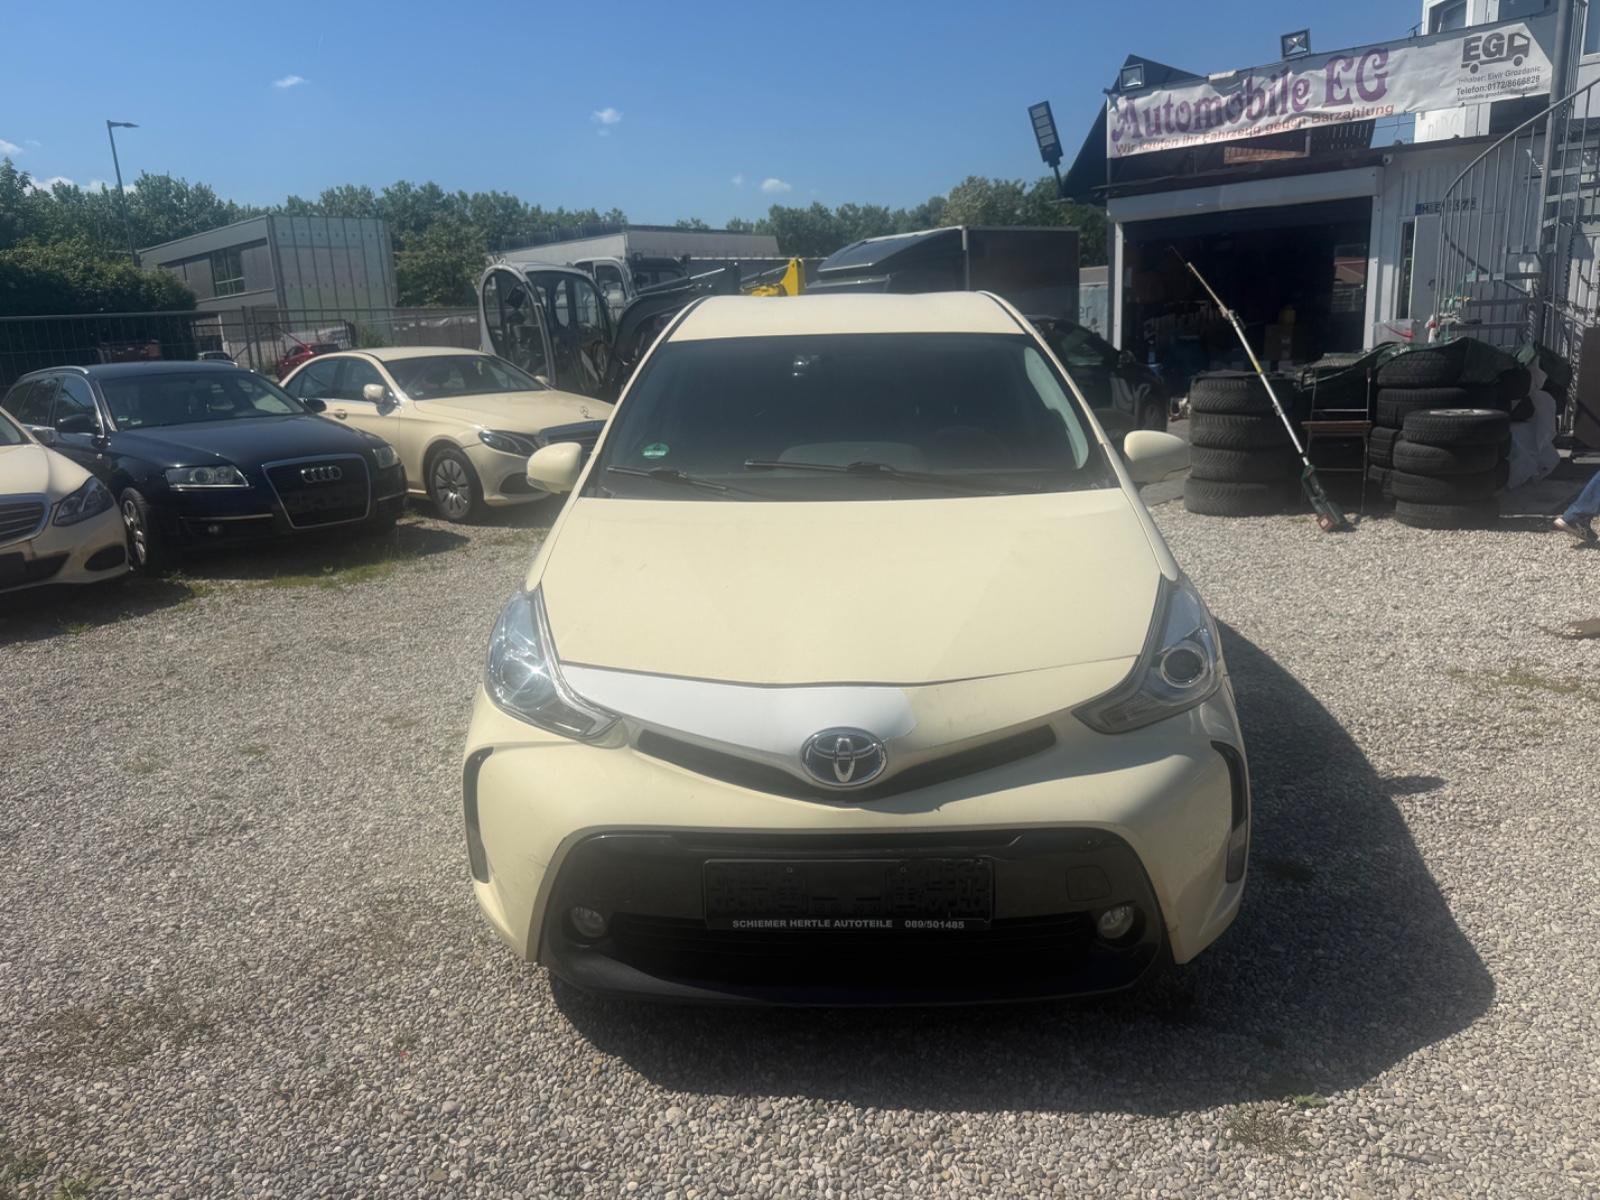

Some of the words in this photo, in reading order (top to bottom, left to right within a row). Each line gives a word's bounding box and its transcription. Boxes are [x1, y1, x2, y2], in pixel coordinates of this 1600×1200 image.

[1112, 66, 1310, 141] Automobile
[1323, 48, 1389, 108] EG
[1116, 142, 1137, 154] Wir
[1265, 117, 1307, 134] gegen
[1311, 104, 1395, 124] Barzahlung
[732, 919, 787, 929] SCHIEMER
[789, 919, 831, 929] HERTLE
[834, 919, 893, 929] AUTOTEILE
